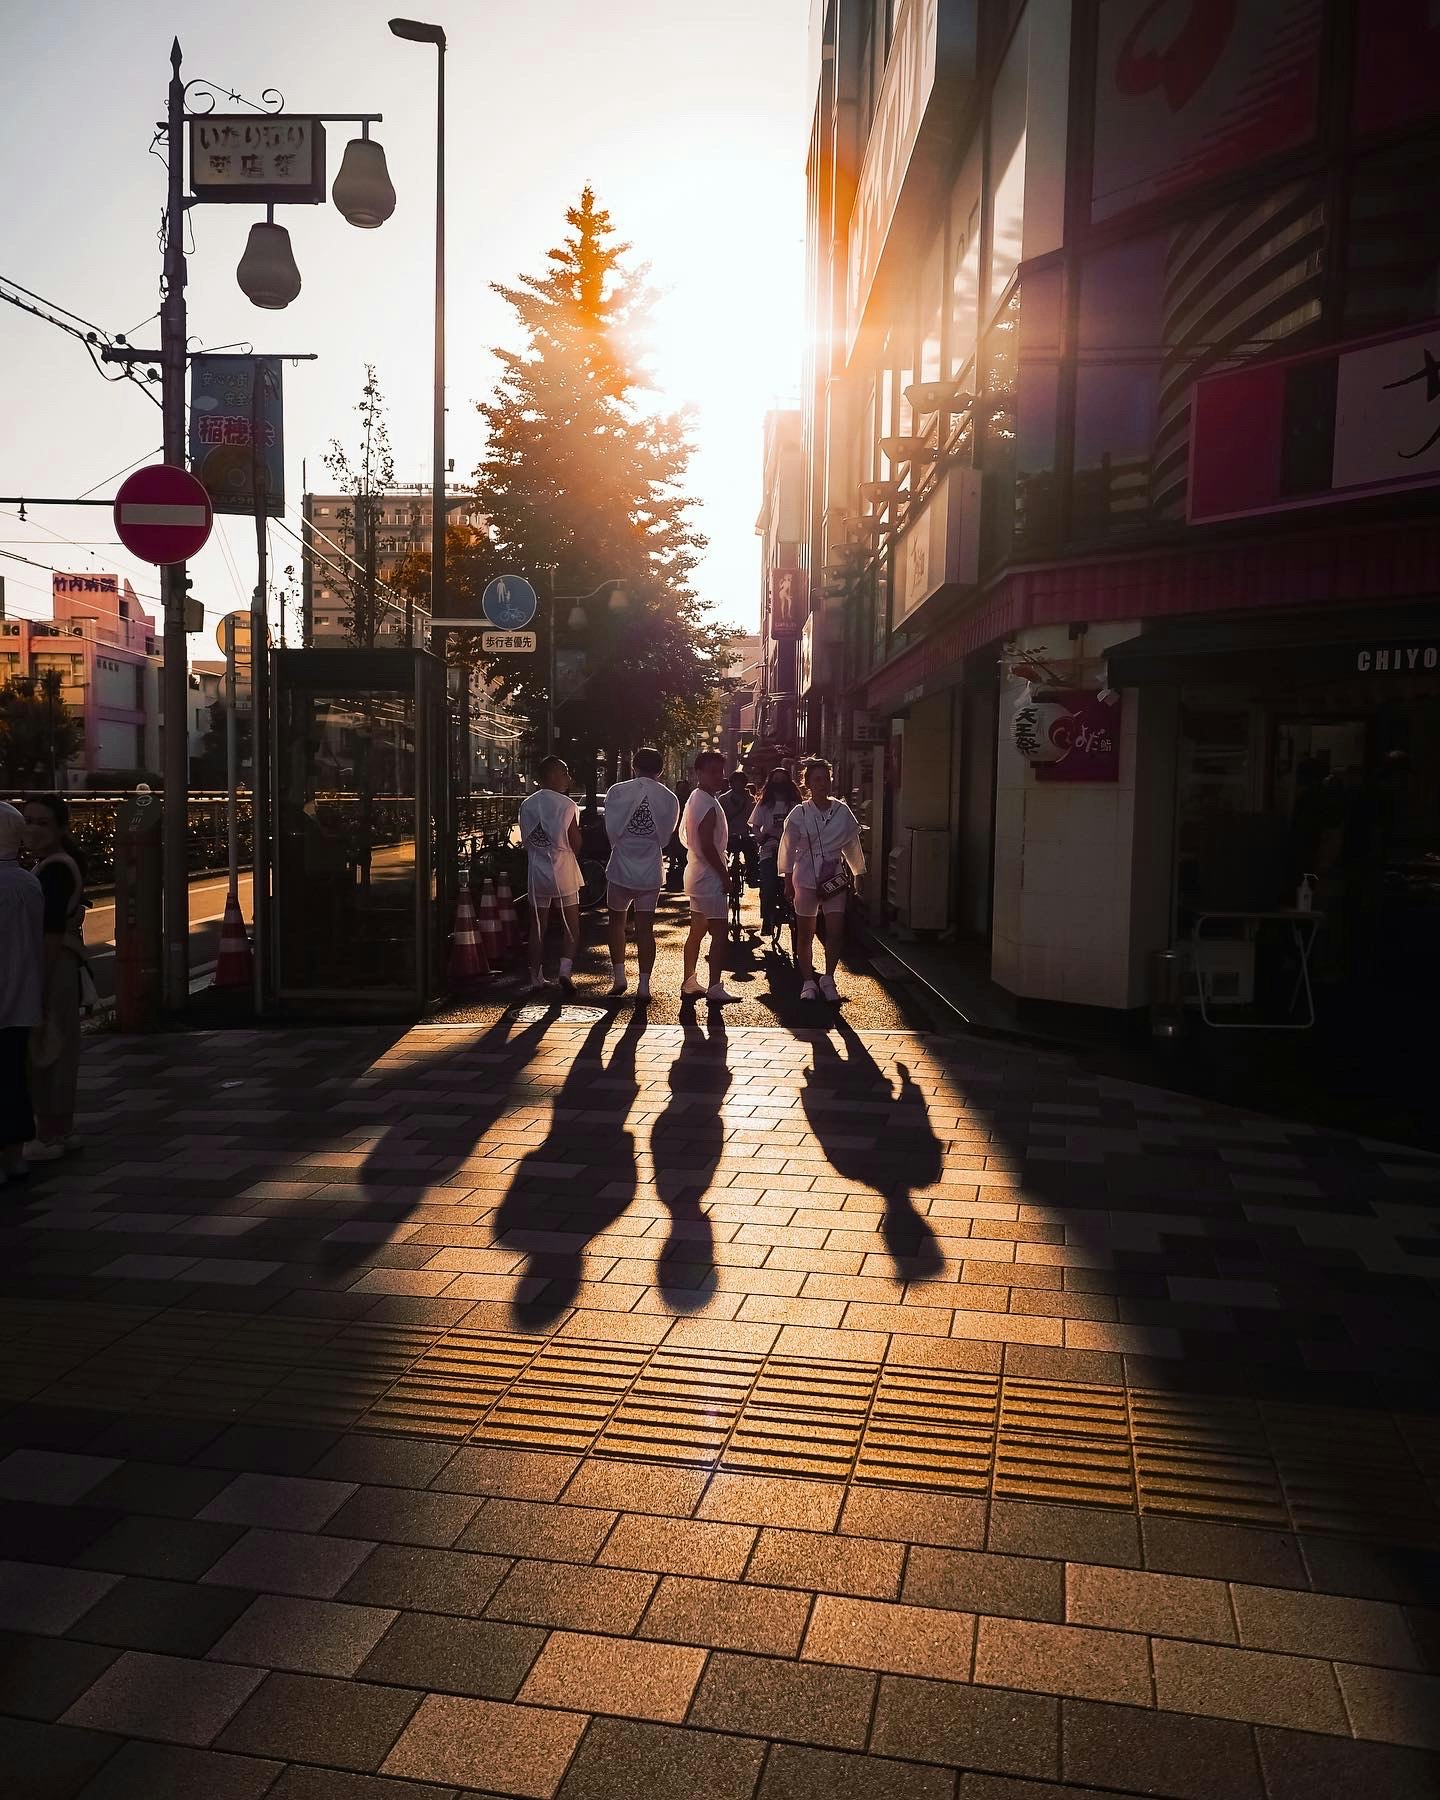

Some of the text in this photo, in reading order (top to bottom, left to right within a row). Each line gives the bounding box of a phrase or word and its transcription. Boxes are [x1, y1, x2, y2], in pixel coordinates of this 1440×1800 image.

[54, 577, 116, 593] 竹内病院
[485, 636, 532, 648] 歩行者優先
